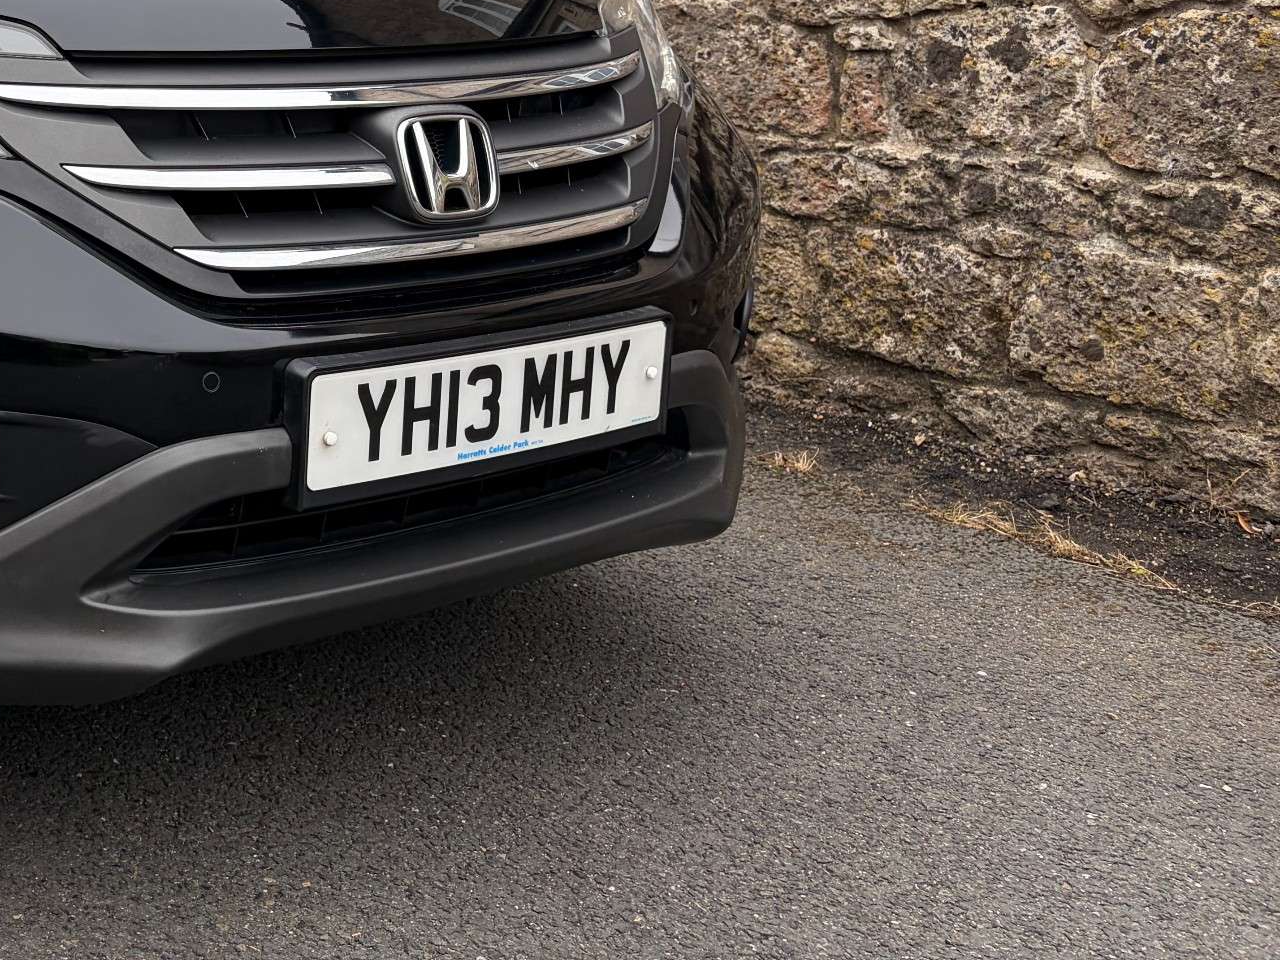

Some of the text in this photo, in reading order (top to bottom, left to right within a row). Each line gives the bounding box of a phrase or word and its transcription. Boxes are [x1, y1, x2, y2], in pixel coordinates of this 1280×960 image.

[357, 340, 631, 462] YH13 MHY
[489, 444, 511, 454] Calder
[513, 440, 528, 449] Park
